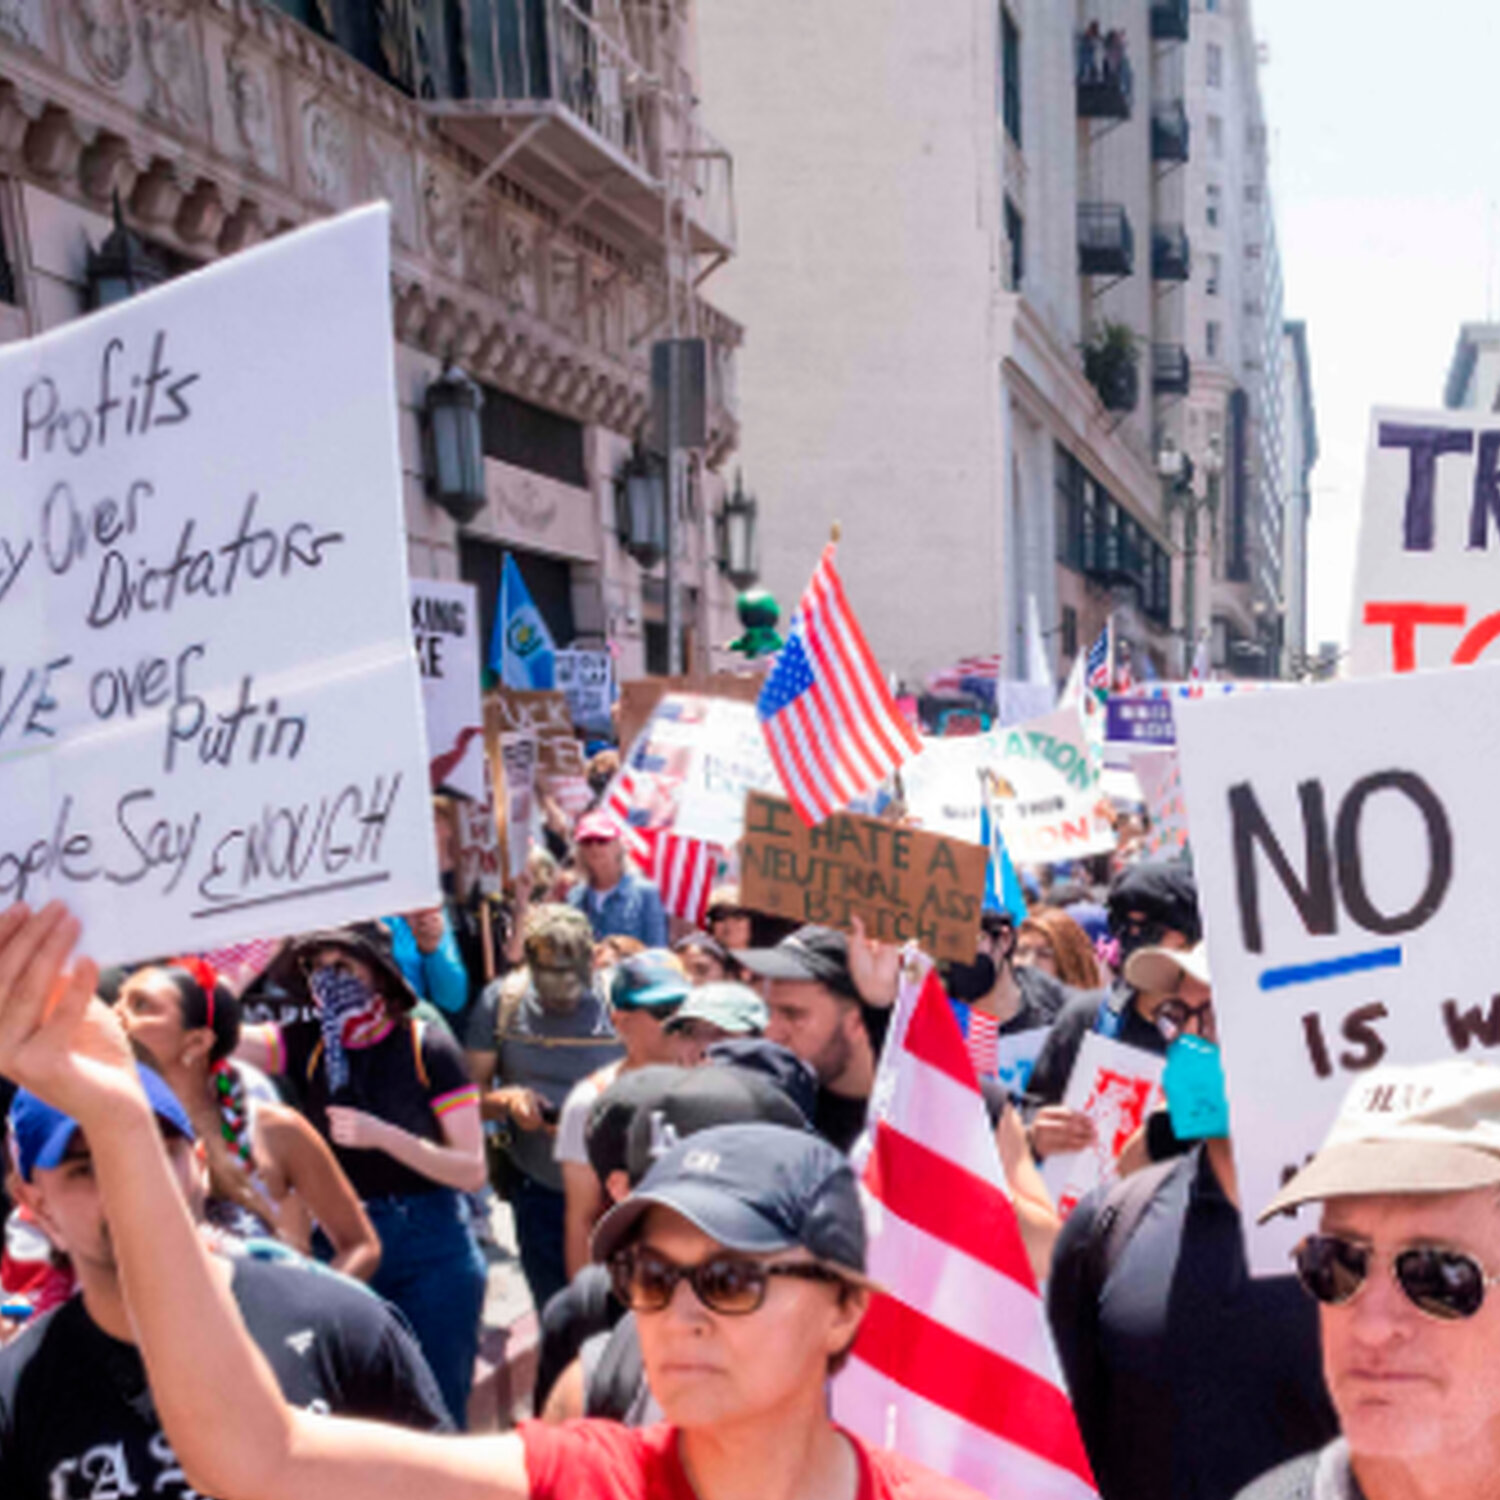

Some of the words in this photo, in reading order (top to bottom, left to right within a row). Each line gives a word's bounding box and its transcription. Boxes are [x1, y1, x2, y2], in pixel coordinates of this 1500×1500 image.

[21, 330, 200, 460] Profits
[43, 478, 154, 575] Over
[86, 492, 344, 629] Dictators
[164, 675, 306, 773] Putin
[105, 788, 201, 896] Say
[199, 772, 402, 901] ENOUGH
[741, 843, 911, 908] NEUTRAL
[917, 883, 977, 923] ASS
[750, 797, 792, 836] I
[810, 815, 913, 871] HATE
[926, 839, 960, 882] A
[1228, 770, 1453, 954] NO
[803, 888, 938, 948] BITCH
[1302, 1002, 1388, 1078] IS
